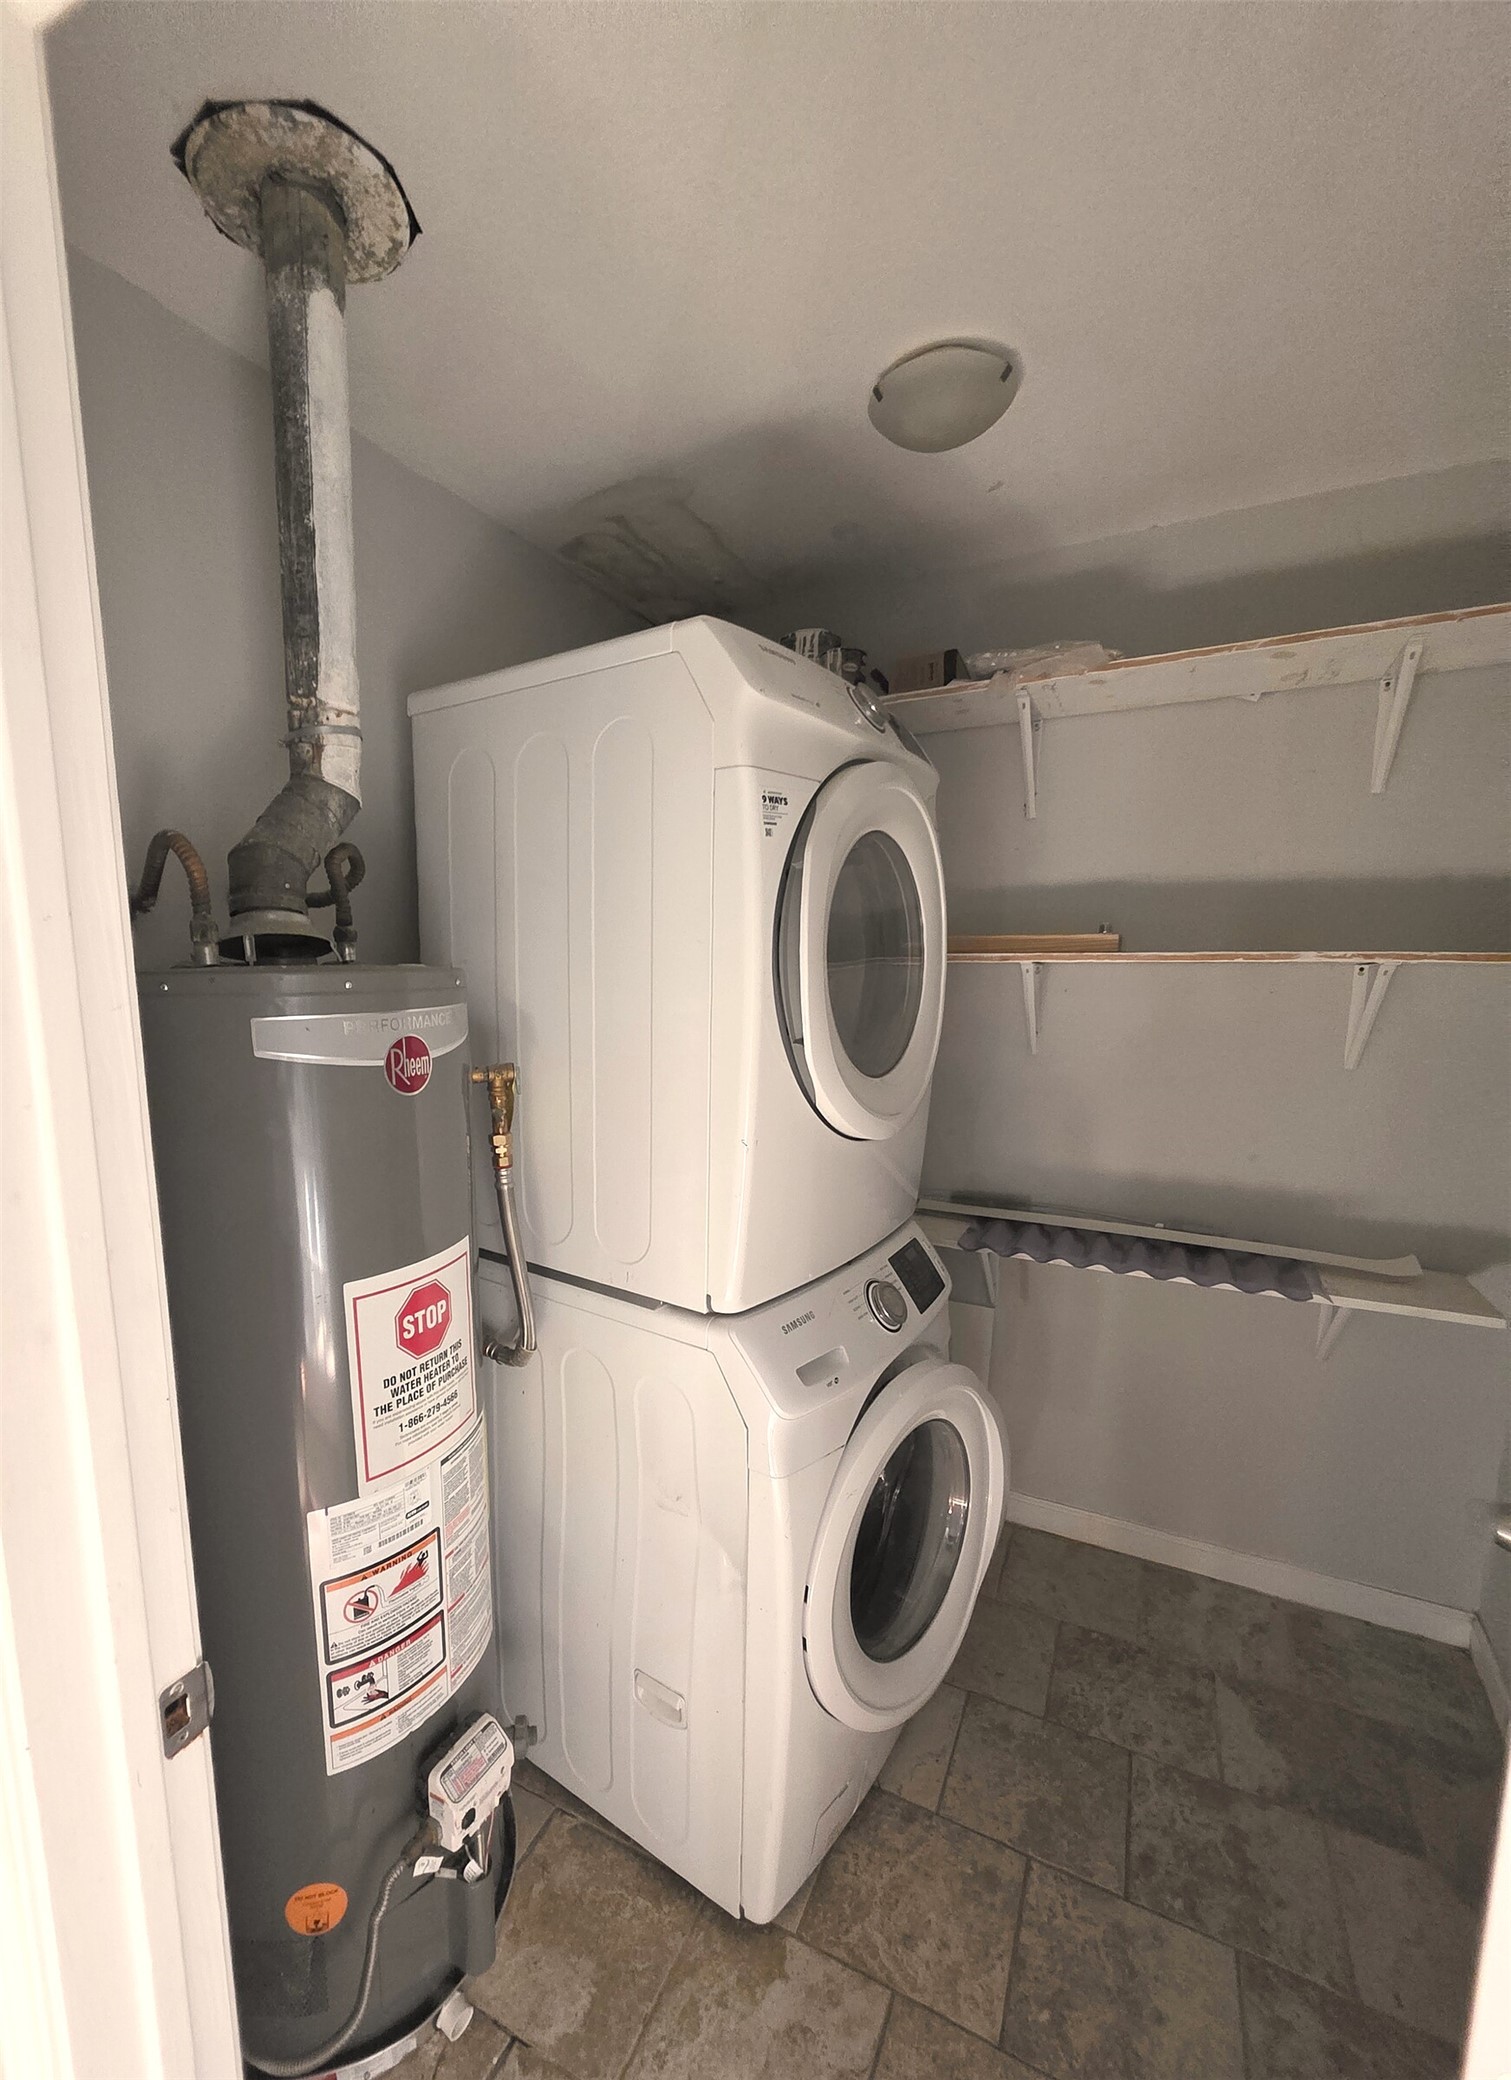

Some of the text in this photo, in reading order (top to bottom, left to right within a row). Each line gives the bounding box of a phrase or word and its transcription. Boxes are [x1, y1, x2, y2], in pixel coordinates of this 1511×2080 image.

[762, 795, 788, 806] 9 WAYS
[390, 1037, 430, 1086] Rheem
[402, 1299, 447, 1340] STOP
[781, 1310, 816, 1335] SAMSUNG
[383, 1338, 462, 1389] DO NOT RETURN THIS
[390, 1353, 459, 1398] WATER HEATER TO
[373, 1356, 468, 1417] THE PLACE OF PURCHASE
[371, 1551, 413, 1575] WARNING
[377, 1639, 412, 1663] DANGER
